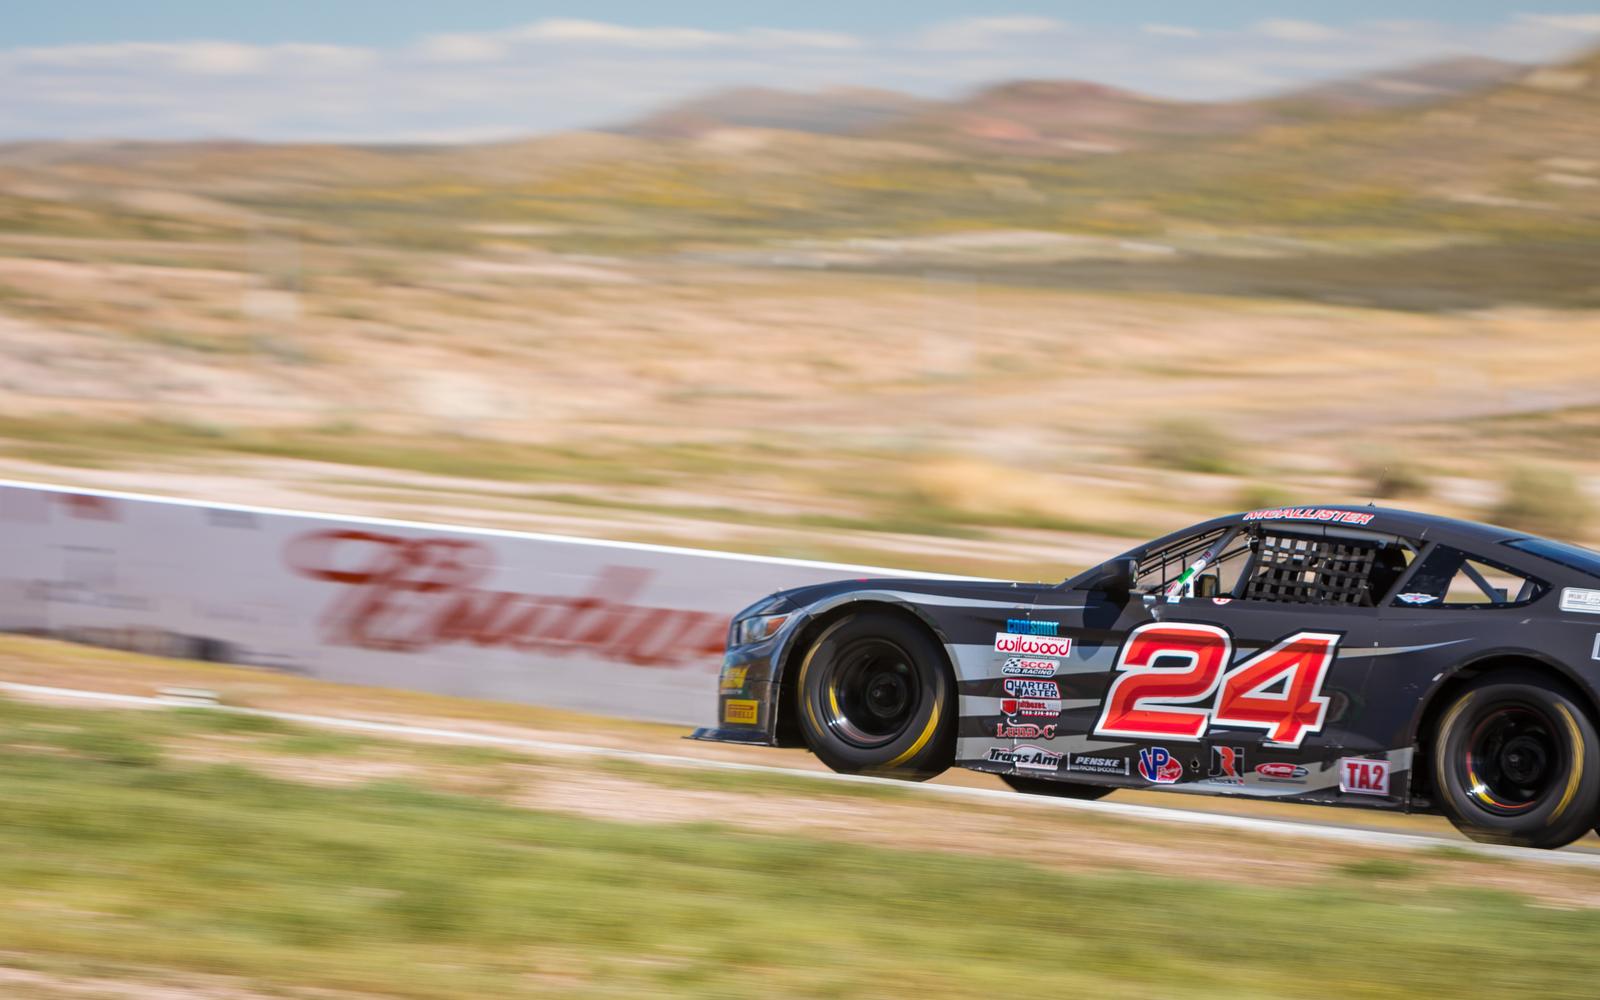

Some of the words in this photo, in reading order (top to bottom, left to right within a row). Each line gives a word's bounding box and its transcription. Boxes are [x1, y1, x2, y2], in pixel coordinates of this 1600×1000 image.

[1007, 618, 1059, 635] COOLSHIRT
[996, 635, 1071, 656] wilwood
[1020, 661, 1054, 669] SCCA
[1021, 668, 1053, 676] RACING
[1005, 680, 1056, 691] QUARTER
[1094, 622, 1341, 749] 24
[1075, 756, 1120, 767] PENSKE
[1140, 746, 1170, 782] VP
[1346, 762, 1385, 791] TA2
